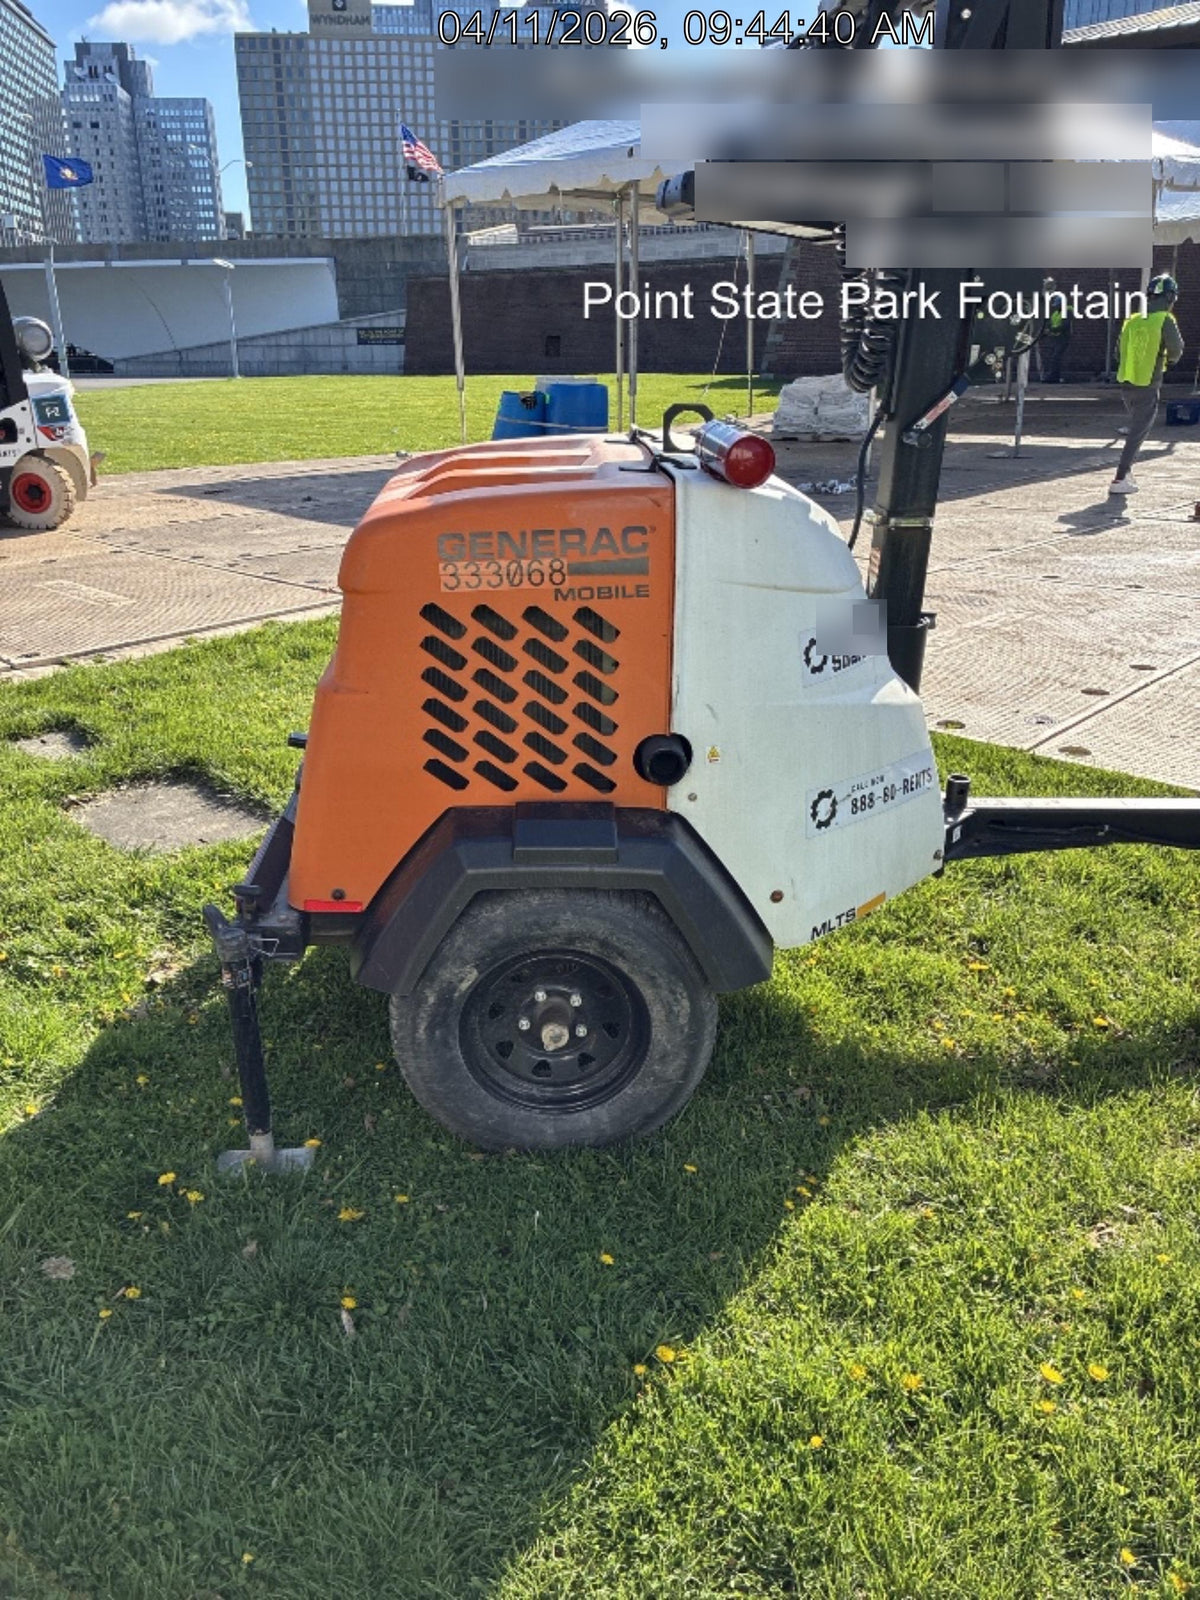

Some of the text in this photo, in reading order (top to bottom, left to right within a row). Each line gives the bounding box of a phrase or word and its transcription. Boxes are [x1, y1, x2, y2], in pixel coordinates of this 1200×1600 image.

[311, 14, 371, 26] WYNDHAM
[436, 525, 650, 562] GENERAC
[441, 558, 567, 591] 333068
[553, 584, 650, 602] MOBILE
[811, 906, 856, 941] MLTS
